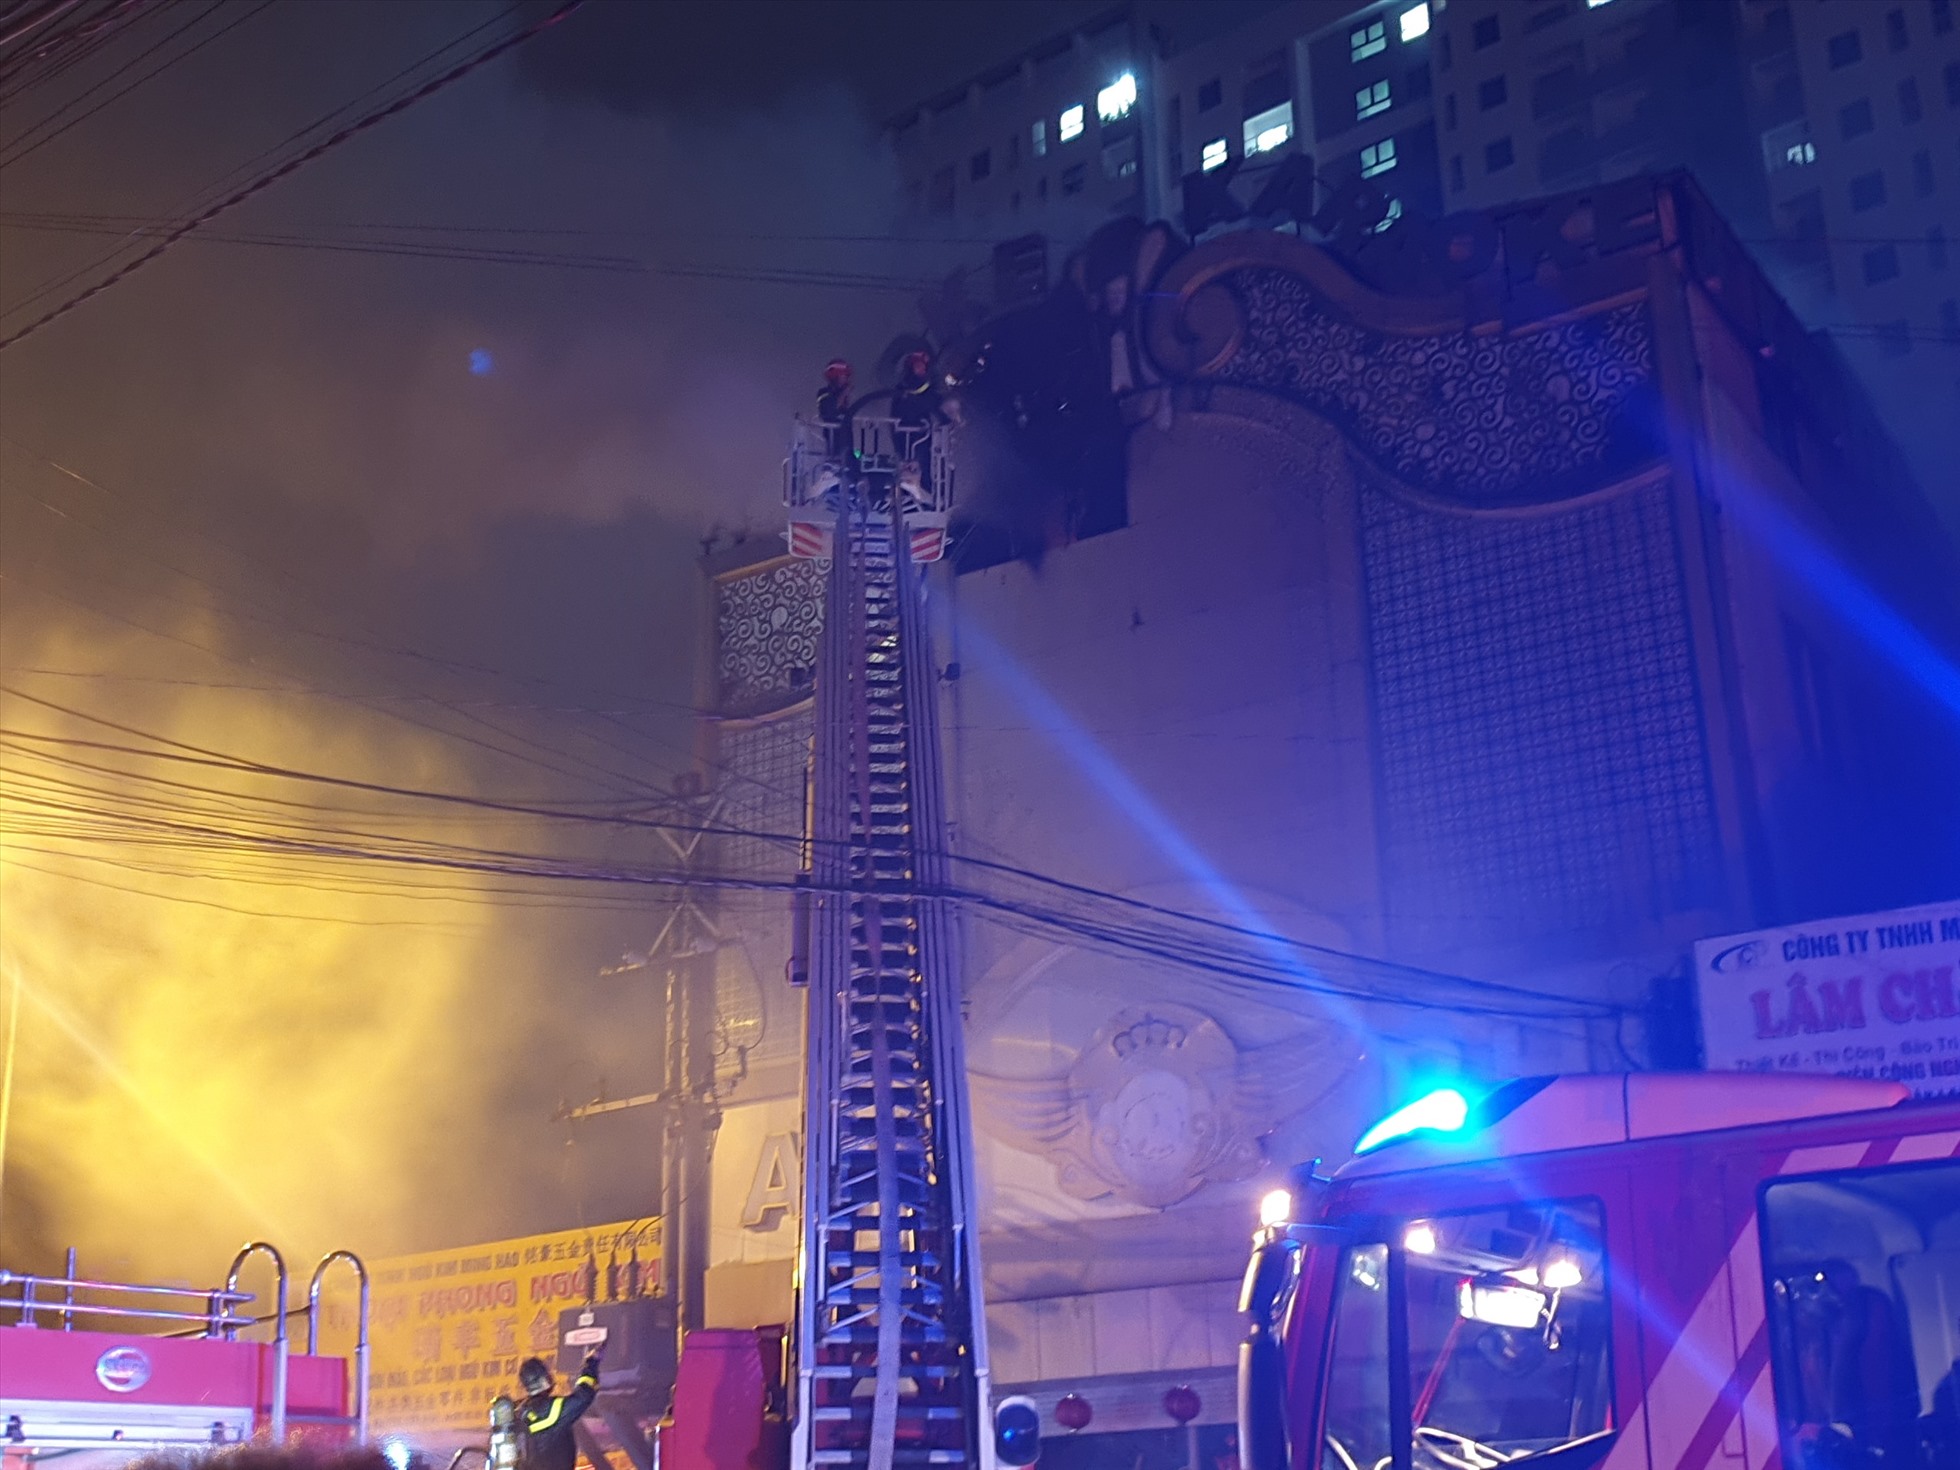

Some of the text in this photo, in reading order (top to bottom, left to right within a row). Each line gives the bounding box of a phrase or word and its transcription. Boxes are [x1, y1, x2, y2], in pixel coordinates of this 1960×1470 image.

[1782, 933, 1841, 963] CÔNG
[1845, 929, 1869, 954] TY
[1875, 919, 1935, 951] TNHH
[1749, 966, 1960, 1040] LÂM CH
[740, 1131, 800, 1230] A
[419, 1278, 517, 1320] PHONG
[608, 1257, 662, 1302] KM
